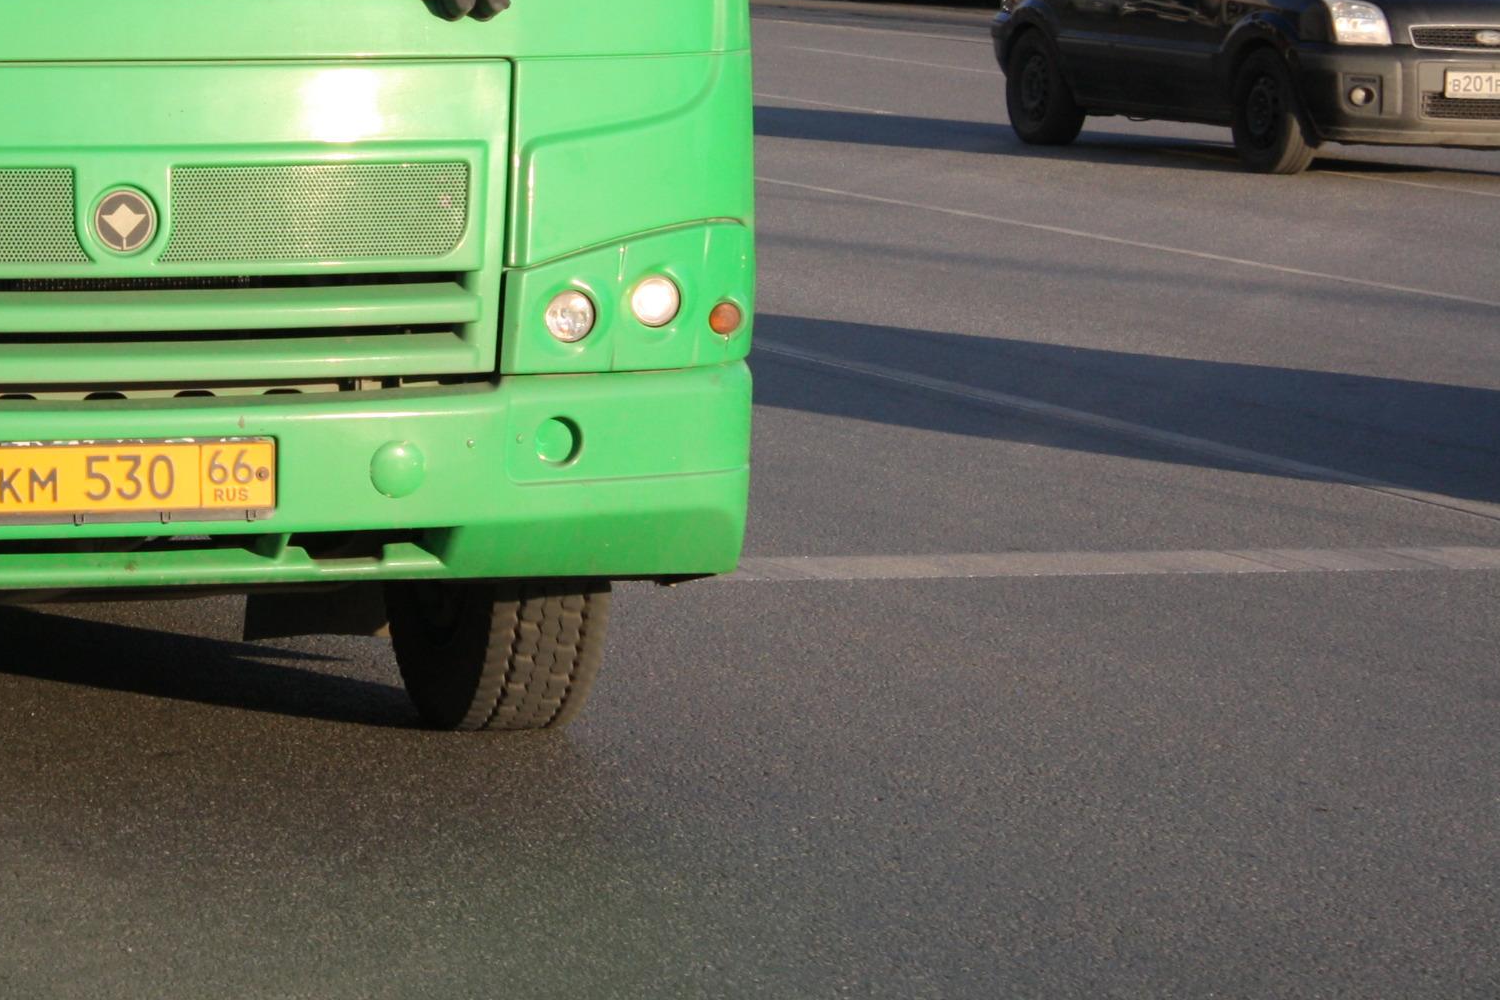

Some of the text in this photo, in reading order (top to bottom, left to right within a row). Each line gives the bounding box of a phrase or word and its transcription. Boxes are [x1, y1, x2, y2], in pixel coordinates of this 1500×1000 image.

[84, 454, 175, 501] 530
[208, 450, 253, 485] 66
[213, 488, 249, 502] RUS
